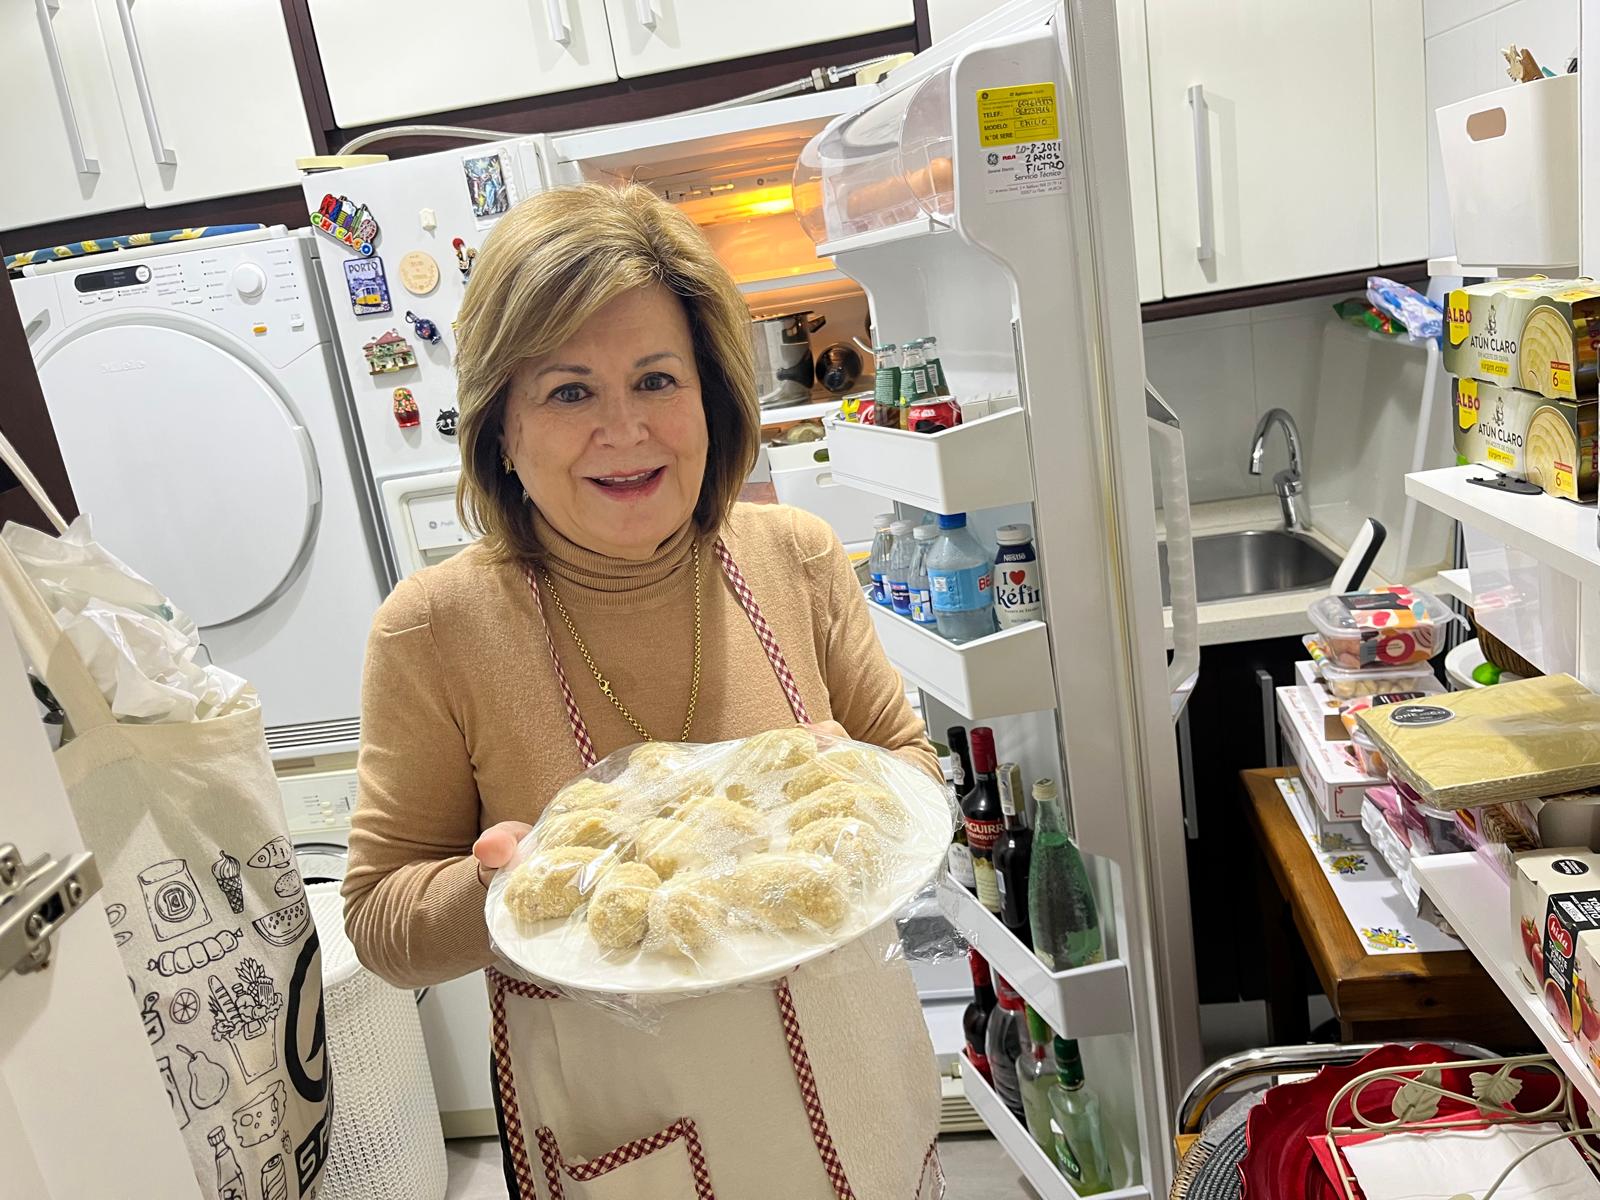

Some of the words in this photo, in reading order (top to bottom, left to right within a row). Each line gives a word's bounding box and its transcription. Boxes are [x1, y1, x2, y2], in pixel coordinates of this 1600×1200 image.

[1026, 160, 1064, 174] FILTRO
[1015, 173, 1038, 181] Servicio
[1040, 170, 1062, 178] Técnico
[348, 261, 378, 274] PORTO
[1447, 306, 1472, 324] ALBO
[1470, 333, 1489, 350] ATÚN
[1490, 338, 1516, 354] CLARO
[1552, 372, 1559, 387] 6
[1456, 392, 1480, 410] ALBO
[1479, 422, 1496, 439] ATÚN
[1498, 429, 1522, 447] CLARO
[1556, 472, 1561, 487] 6
[1003, 572, 1008, 585] I
[1551, 921, 1568, 950] hida
